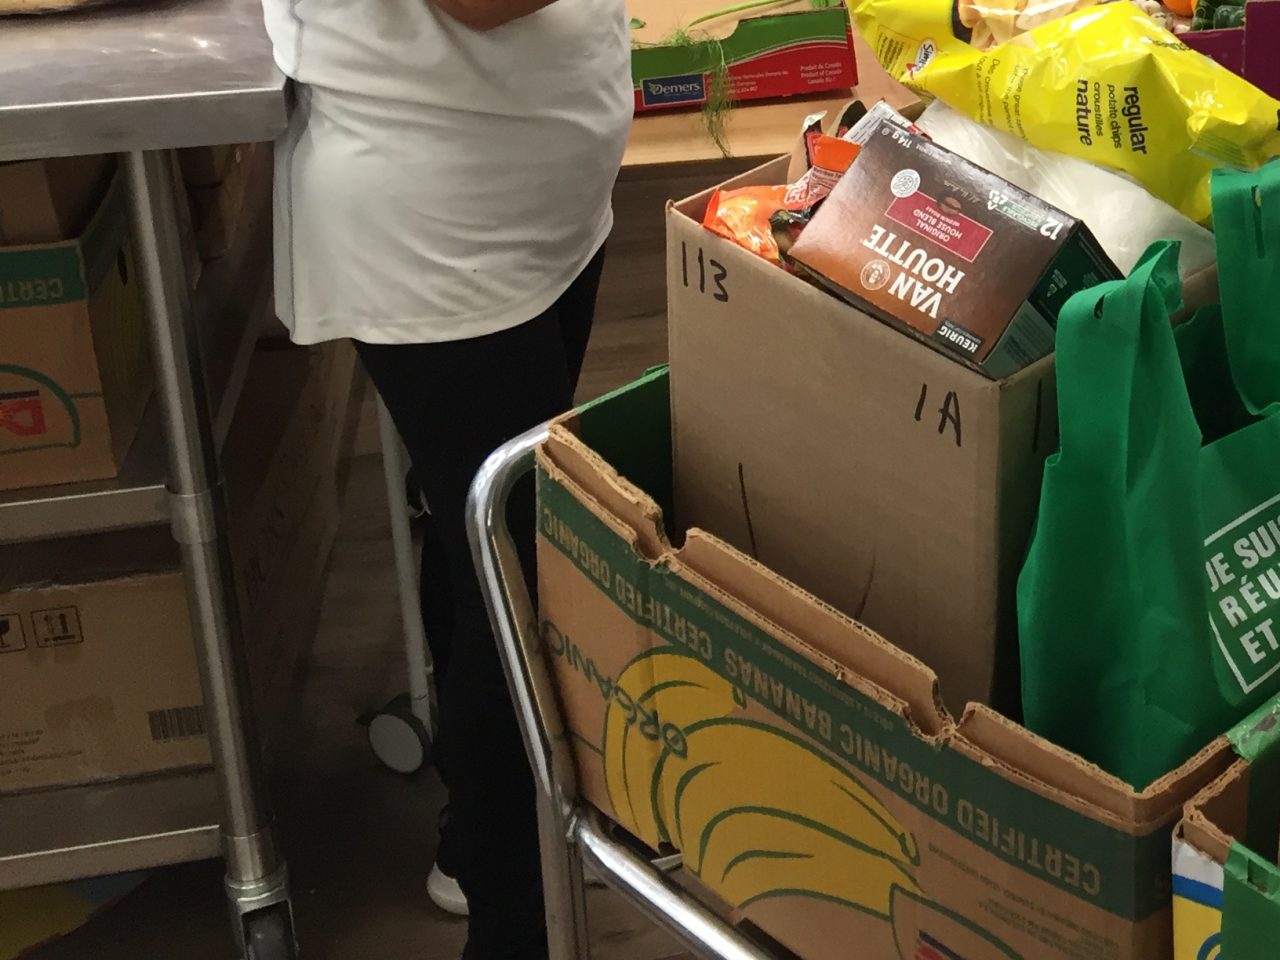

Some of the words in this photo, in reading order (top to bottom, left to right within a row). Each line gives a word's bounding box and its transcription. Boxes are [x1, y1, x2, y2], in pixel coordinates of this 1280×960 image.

[648, 81, 700, 96] Demers
[1093, 81, 1104, 138] croustilles
[1107, 84, 1118, 121] potato
[1075, 79, 1093, 147] nature
[1111, 121, 1122, 150] chips
[1122, 85, 1149, 155] regular
[913, 208, 939, 227] BLEND
[916, 218, 951, 242] ORIGINAL
[937, 219, 963, 239] HOUSE
[1039, 215, 1064, 240] 12
[678, 240, 730, 304] 113
[861, 224, 966, 293] HOUTTE
[887, 271, 945, 318] VAN
[938, 324, 979, 353] KEURIG
[541, 506, 612, 591] ORGANIC
[1205, 551, 1236, 593] JE
[614, 571, 714, 662] CERTIFIED
[1239, 617, 1280, 665] ET
[724, 645, 834, 742] BANANAS
[839, 723, 949, 813] ORGANIC
[957, 797, 1102, 897] CERTIFIED
